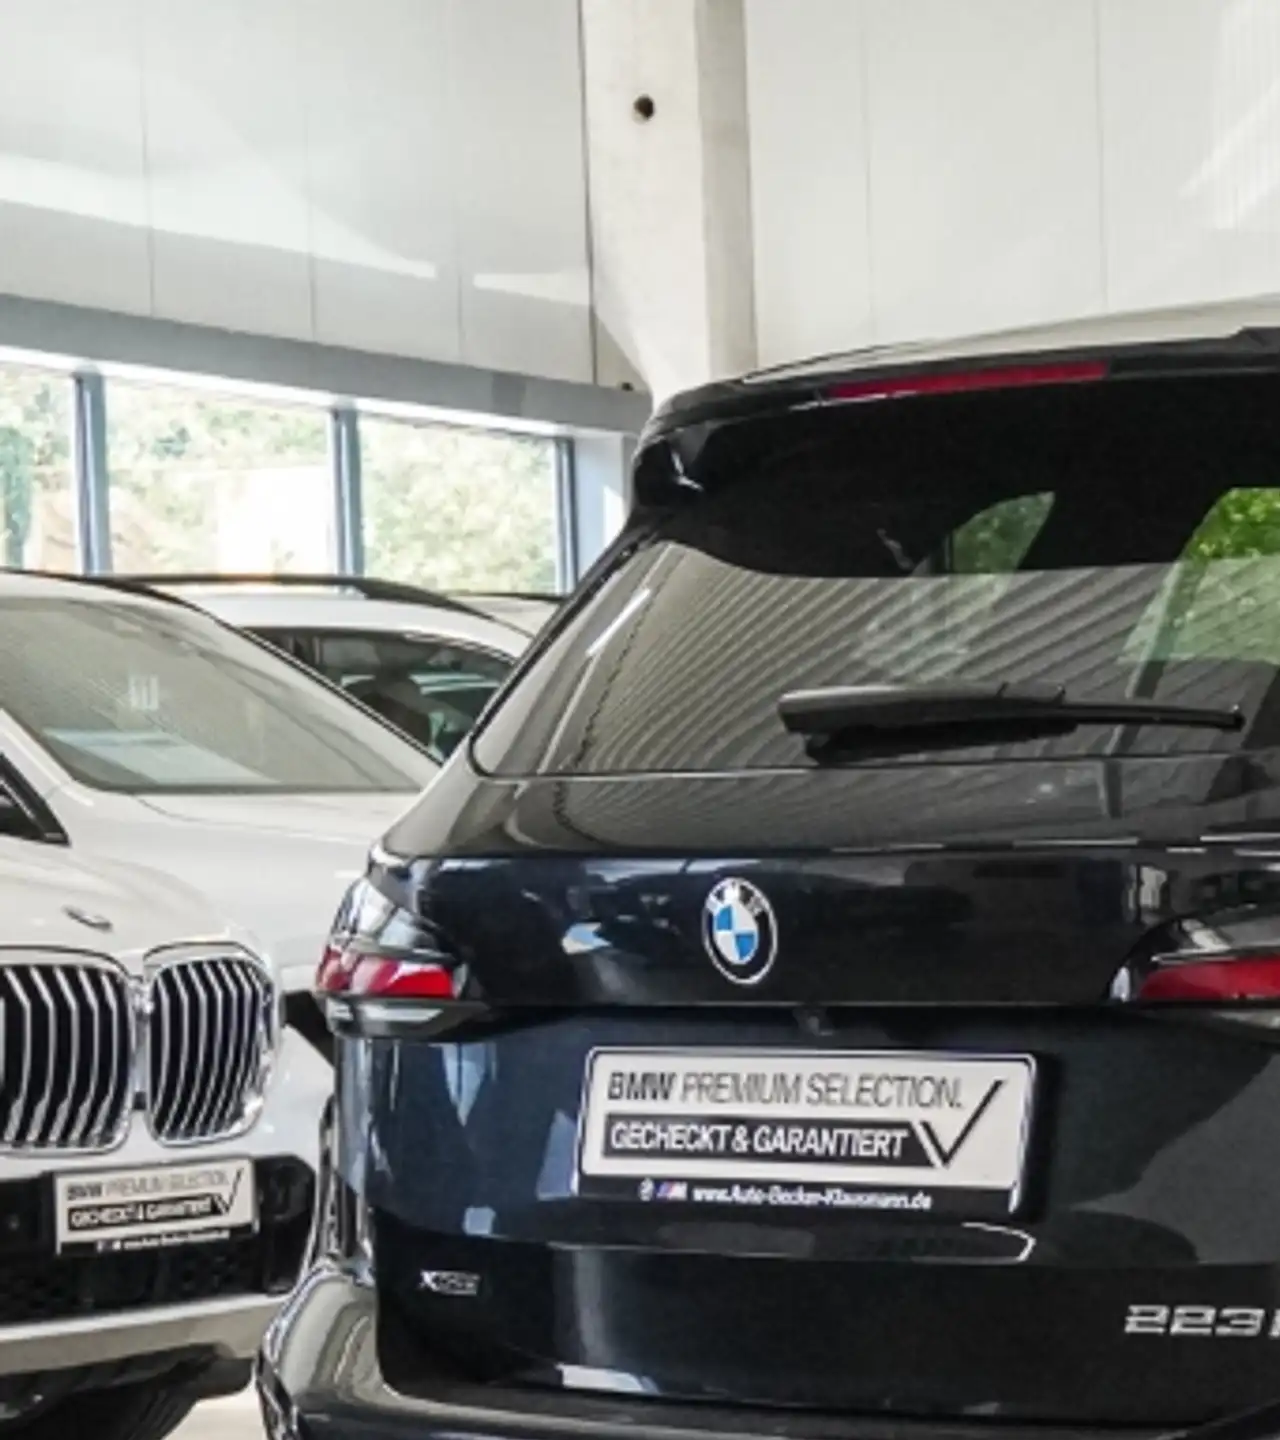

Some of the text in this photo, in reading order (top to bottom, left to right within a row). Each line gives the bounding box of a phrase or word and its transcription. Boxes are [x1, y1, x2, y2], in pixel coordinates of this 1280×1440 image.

[606, 1071, 676, 1101] BMW
[678, 1072, 802, 1105] PREMIUM
[611, 1121, 909, 1158] GECHECKT & GARANTIERT
